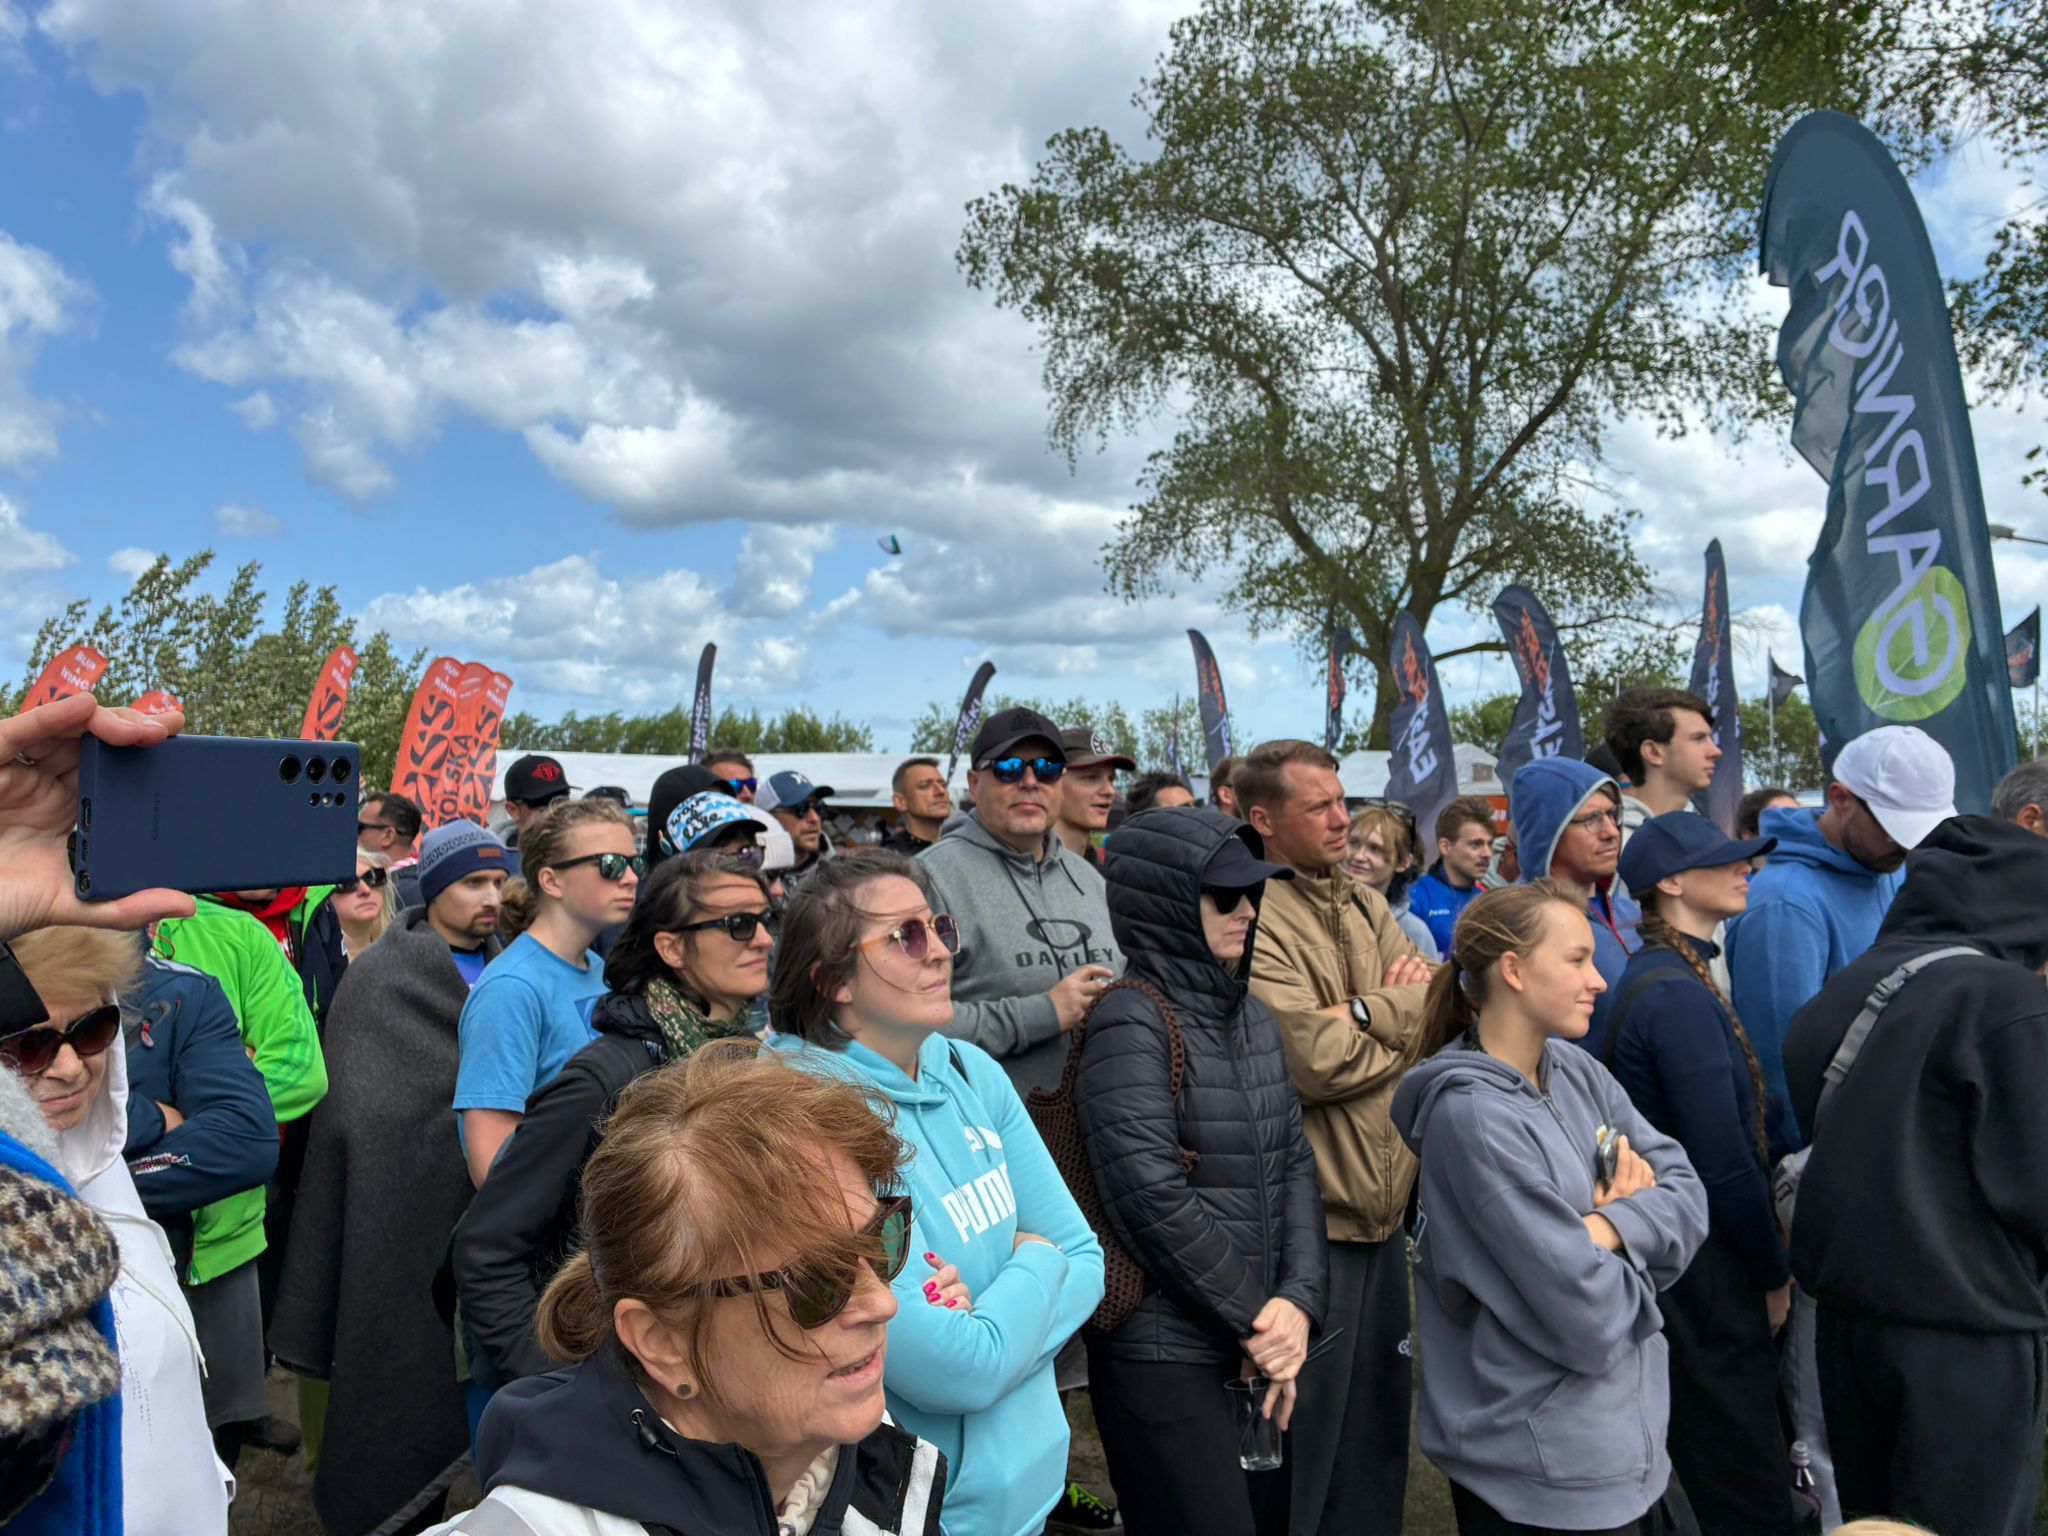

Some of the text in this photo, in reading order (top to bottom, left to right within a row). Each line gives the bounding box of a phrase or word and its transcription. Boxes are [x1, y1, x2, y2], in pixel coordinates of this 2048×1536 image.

[75, 650, 97, 671] SUP
[443, 660, 461, 678] SUP
[60, 665, 97, 692] WING
[434, 676, 458, 698] WING
[493, 676, 508, 690] SUP
[1015, 948, 1114, 969] OAKLEY
